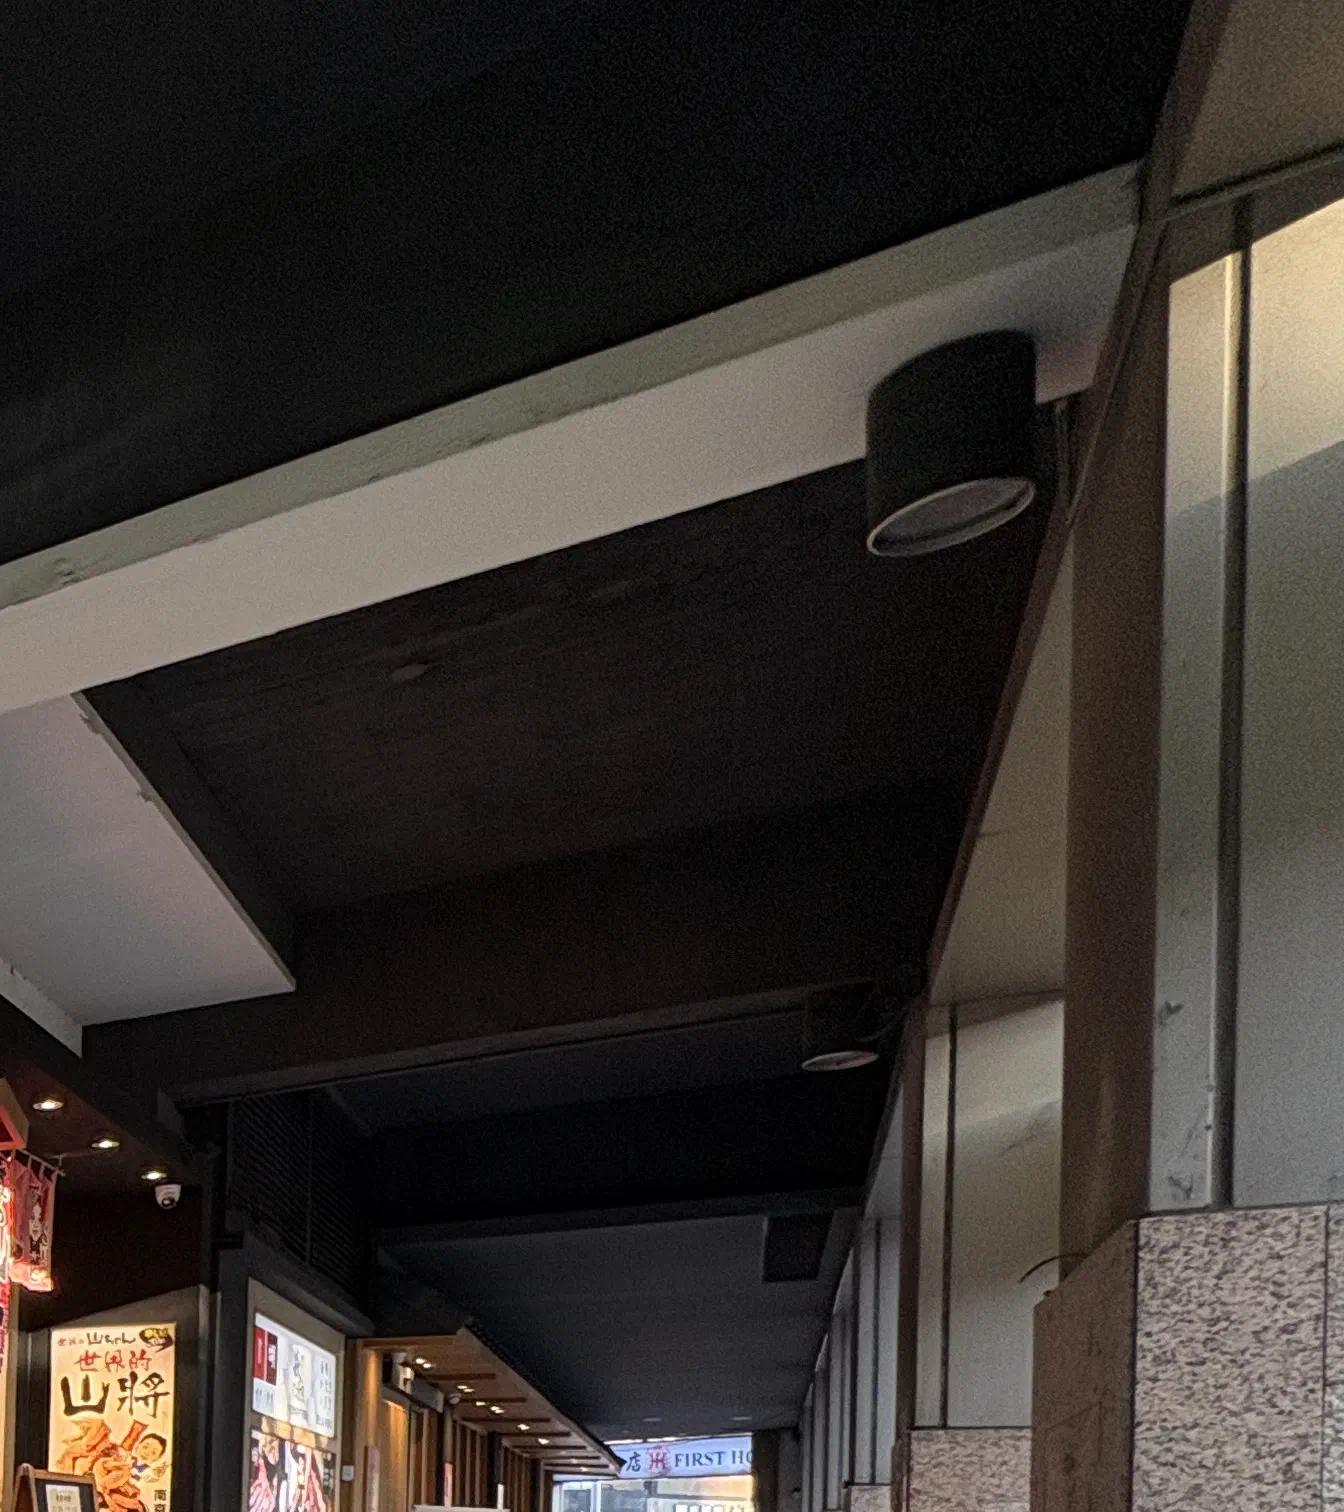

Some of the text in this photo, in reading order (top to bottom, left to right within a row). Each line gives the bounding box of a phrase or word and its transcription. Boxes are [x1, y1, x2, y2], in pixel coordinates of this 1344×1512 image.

[74, 1349, 152, 1372] 世界的
[60, 1371, 170, 1419] 山將
[674, 1452, 726, 1467] FIRST
